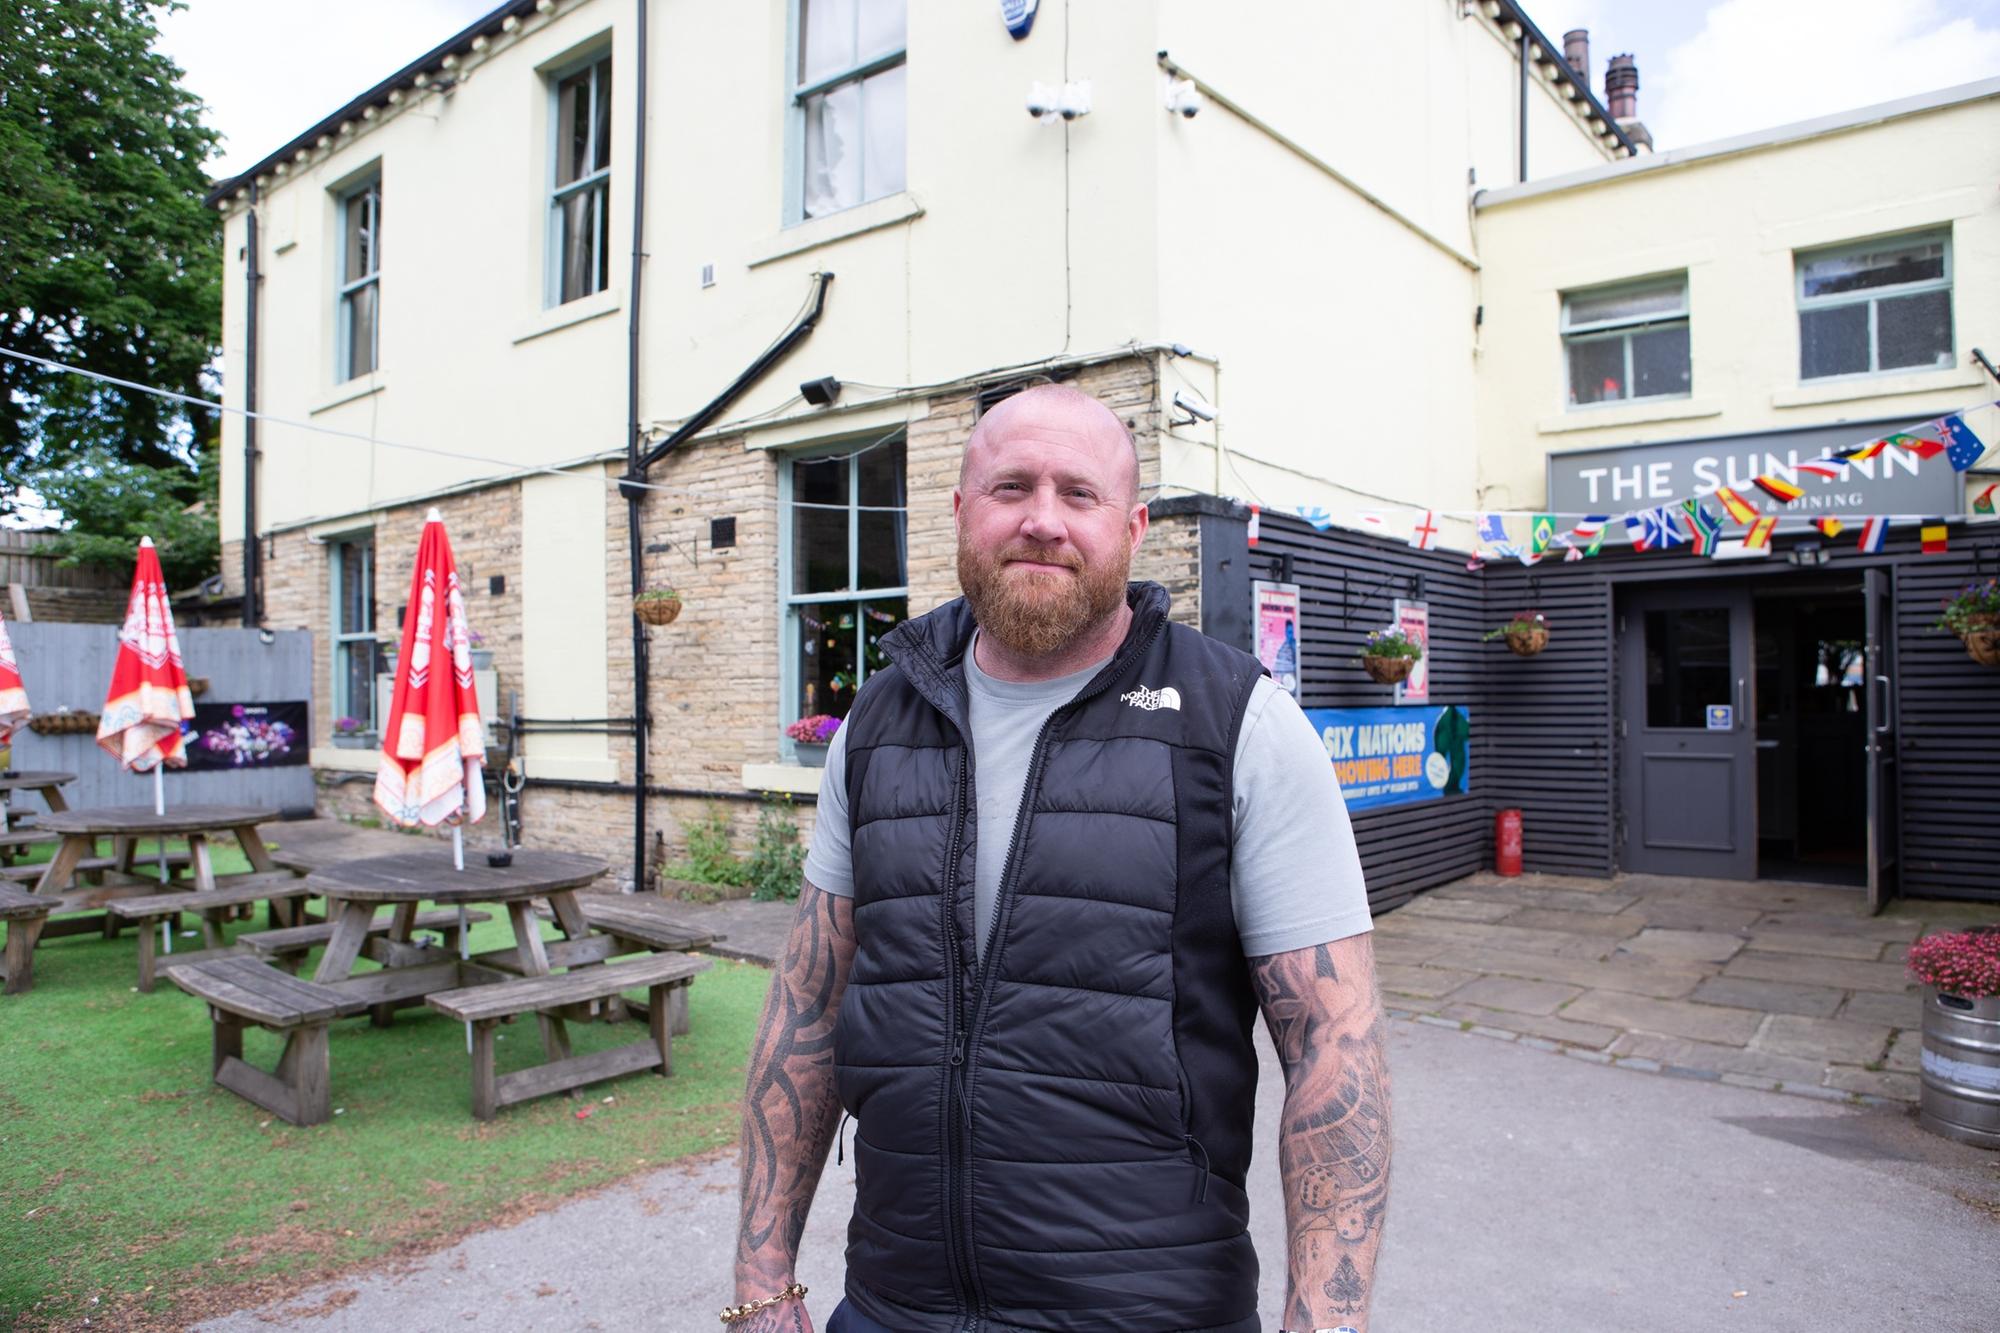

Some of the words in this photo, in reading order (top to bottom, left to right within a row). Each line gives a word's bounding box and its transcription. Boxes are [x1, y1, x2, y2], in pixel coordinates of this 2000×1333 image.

[1578, 461, 1673, 503] THE
[1692, 449, 1799, 497] SUN
[1786, 492, 1863, 511] DINING
[1120, 690, 1160, 705] NORTH
[1140, 684, 1161, 699] THE
[1129, 699, 1160, 711] FACE
[1323, 725, 1354, 759] SIX
[1357, 721, 1426, 757] NATIONS
[1332, 757, 1390, 784] HOWING
[1392, 753, 1423, 778] HERE
